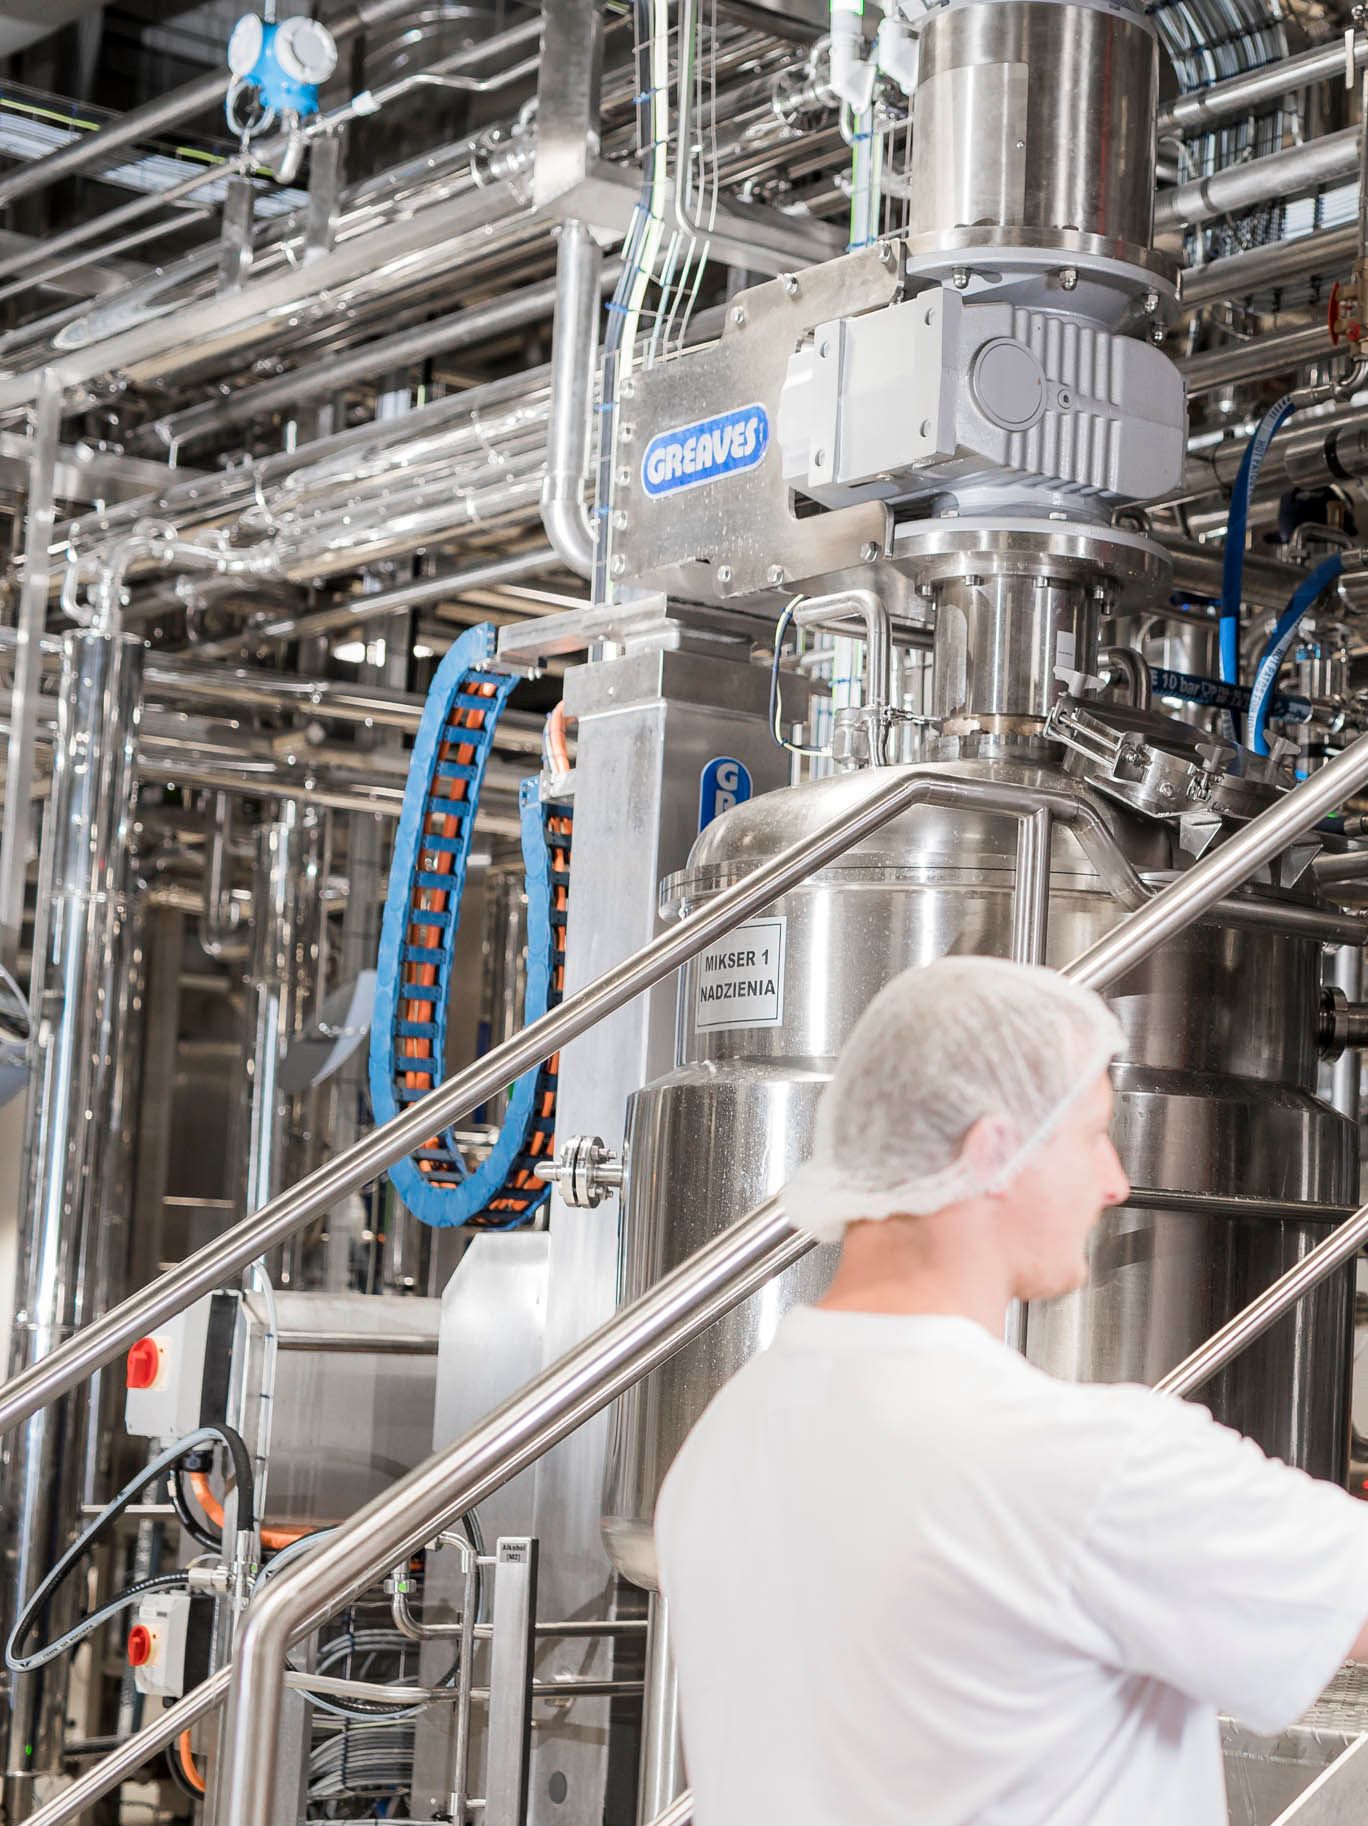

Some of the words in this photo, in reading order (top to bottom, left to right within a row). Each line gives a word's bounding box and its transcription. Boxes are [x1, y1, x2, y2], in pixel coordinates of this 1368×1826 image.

[646, 416, 759, 485] GREAVES
[705, 950, 756, 973] MIKSER
[761, 949, 769, 965] 1
[700, 979, 776, 1003] NADZIENIA
